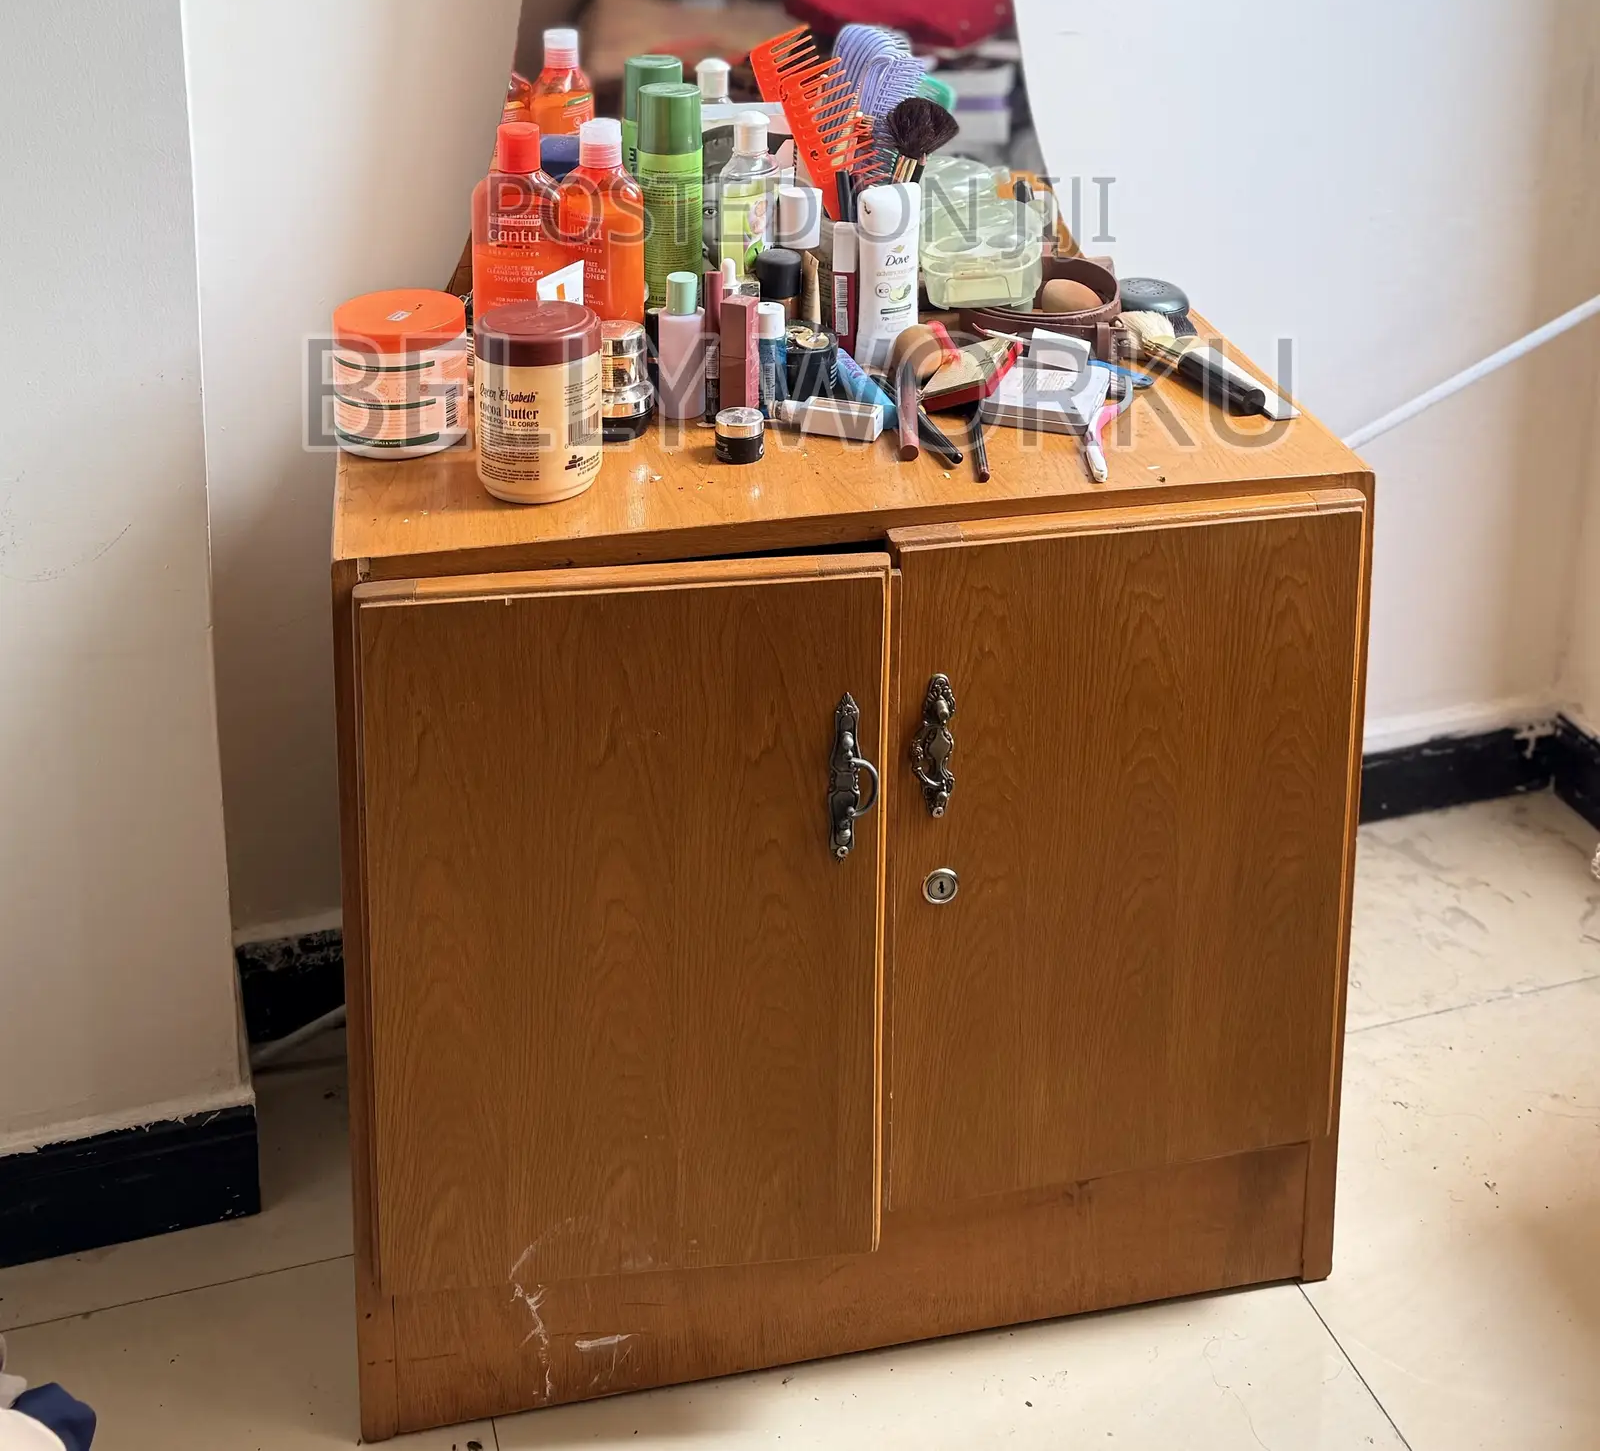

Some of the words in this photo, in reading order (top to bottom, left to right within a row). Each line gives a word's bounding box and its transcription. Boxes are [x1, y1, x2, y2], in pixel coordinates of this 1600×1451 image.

[488, 229, 541, 243] cantu
[885, 255, 910, 266] Dove
[493, 275, 535, 284] SHAMPOO
[504, 405, 539, 420] butter
